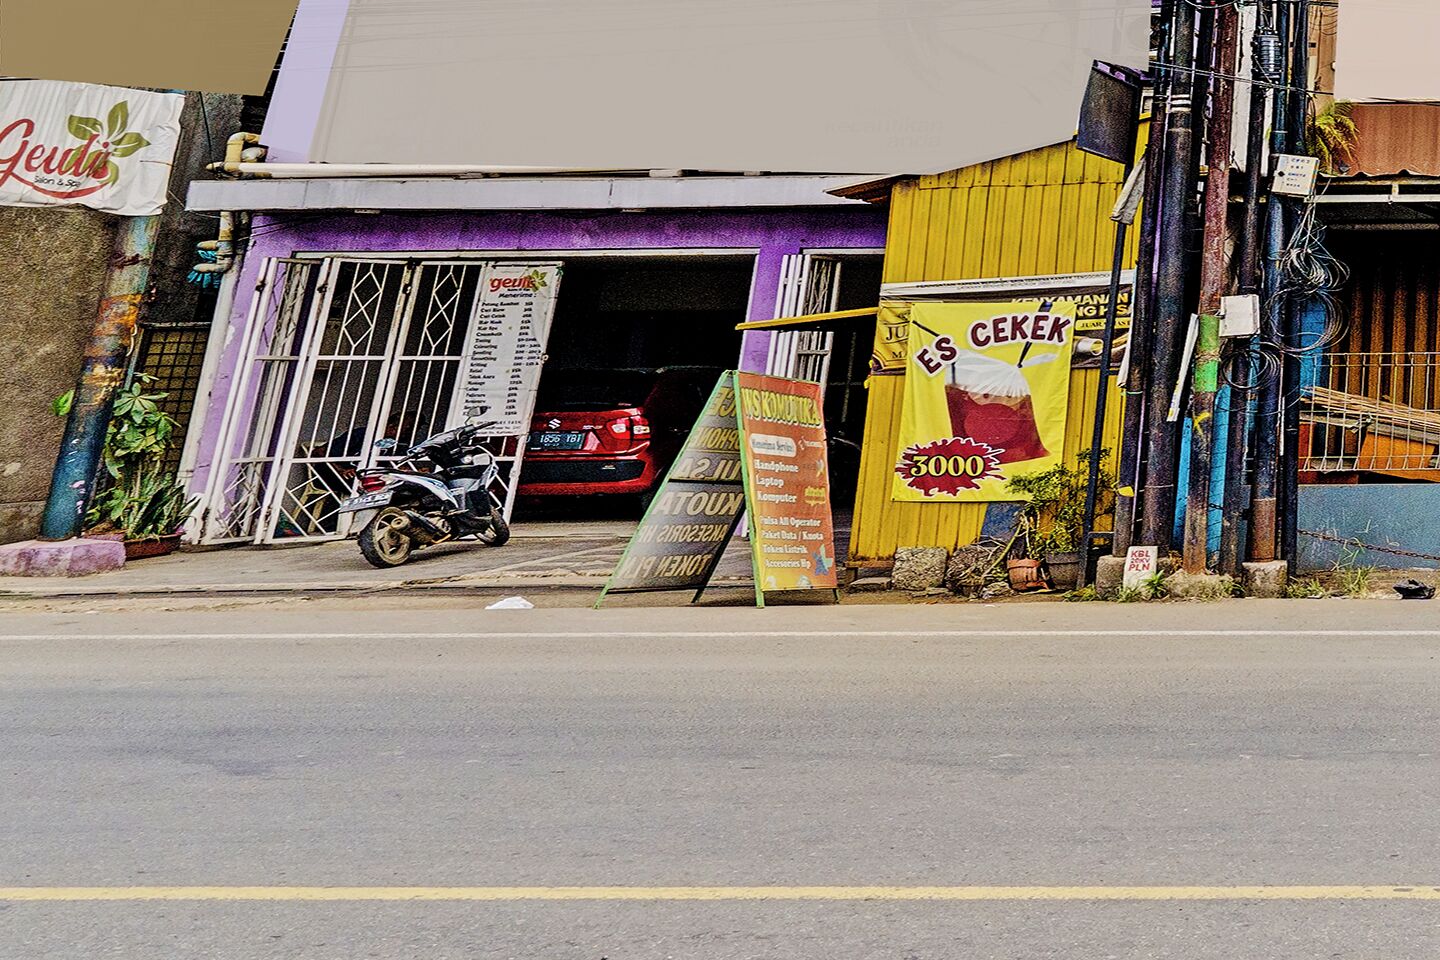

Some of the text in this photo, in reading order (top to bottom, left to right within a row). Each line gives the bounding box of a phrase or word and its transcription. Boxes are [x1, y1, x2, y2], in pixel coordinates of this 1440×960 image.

[34, 175, 55, 185] Salon
[65, 179, 82, 188] Spa
[885, 325, 908, 341] JU
[917, 314, 1071, 374] ES CEKEK
[754, 459, 799, 473] Handphone
[910, 455, 985, 477] 3000
[755, 474, 784, 488] Laptop
[757, 491, 797, 503] Komputer
[1128, 563, 1150, 571] PLN
